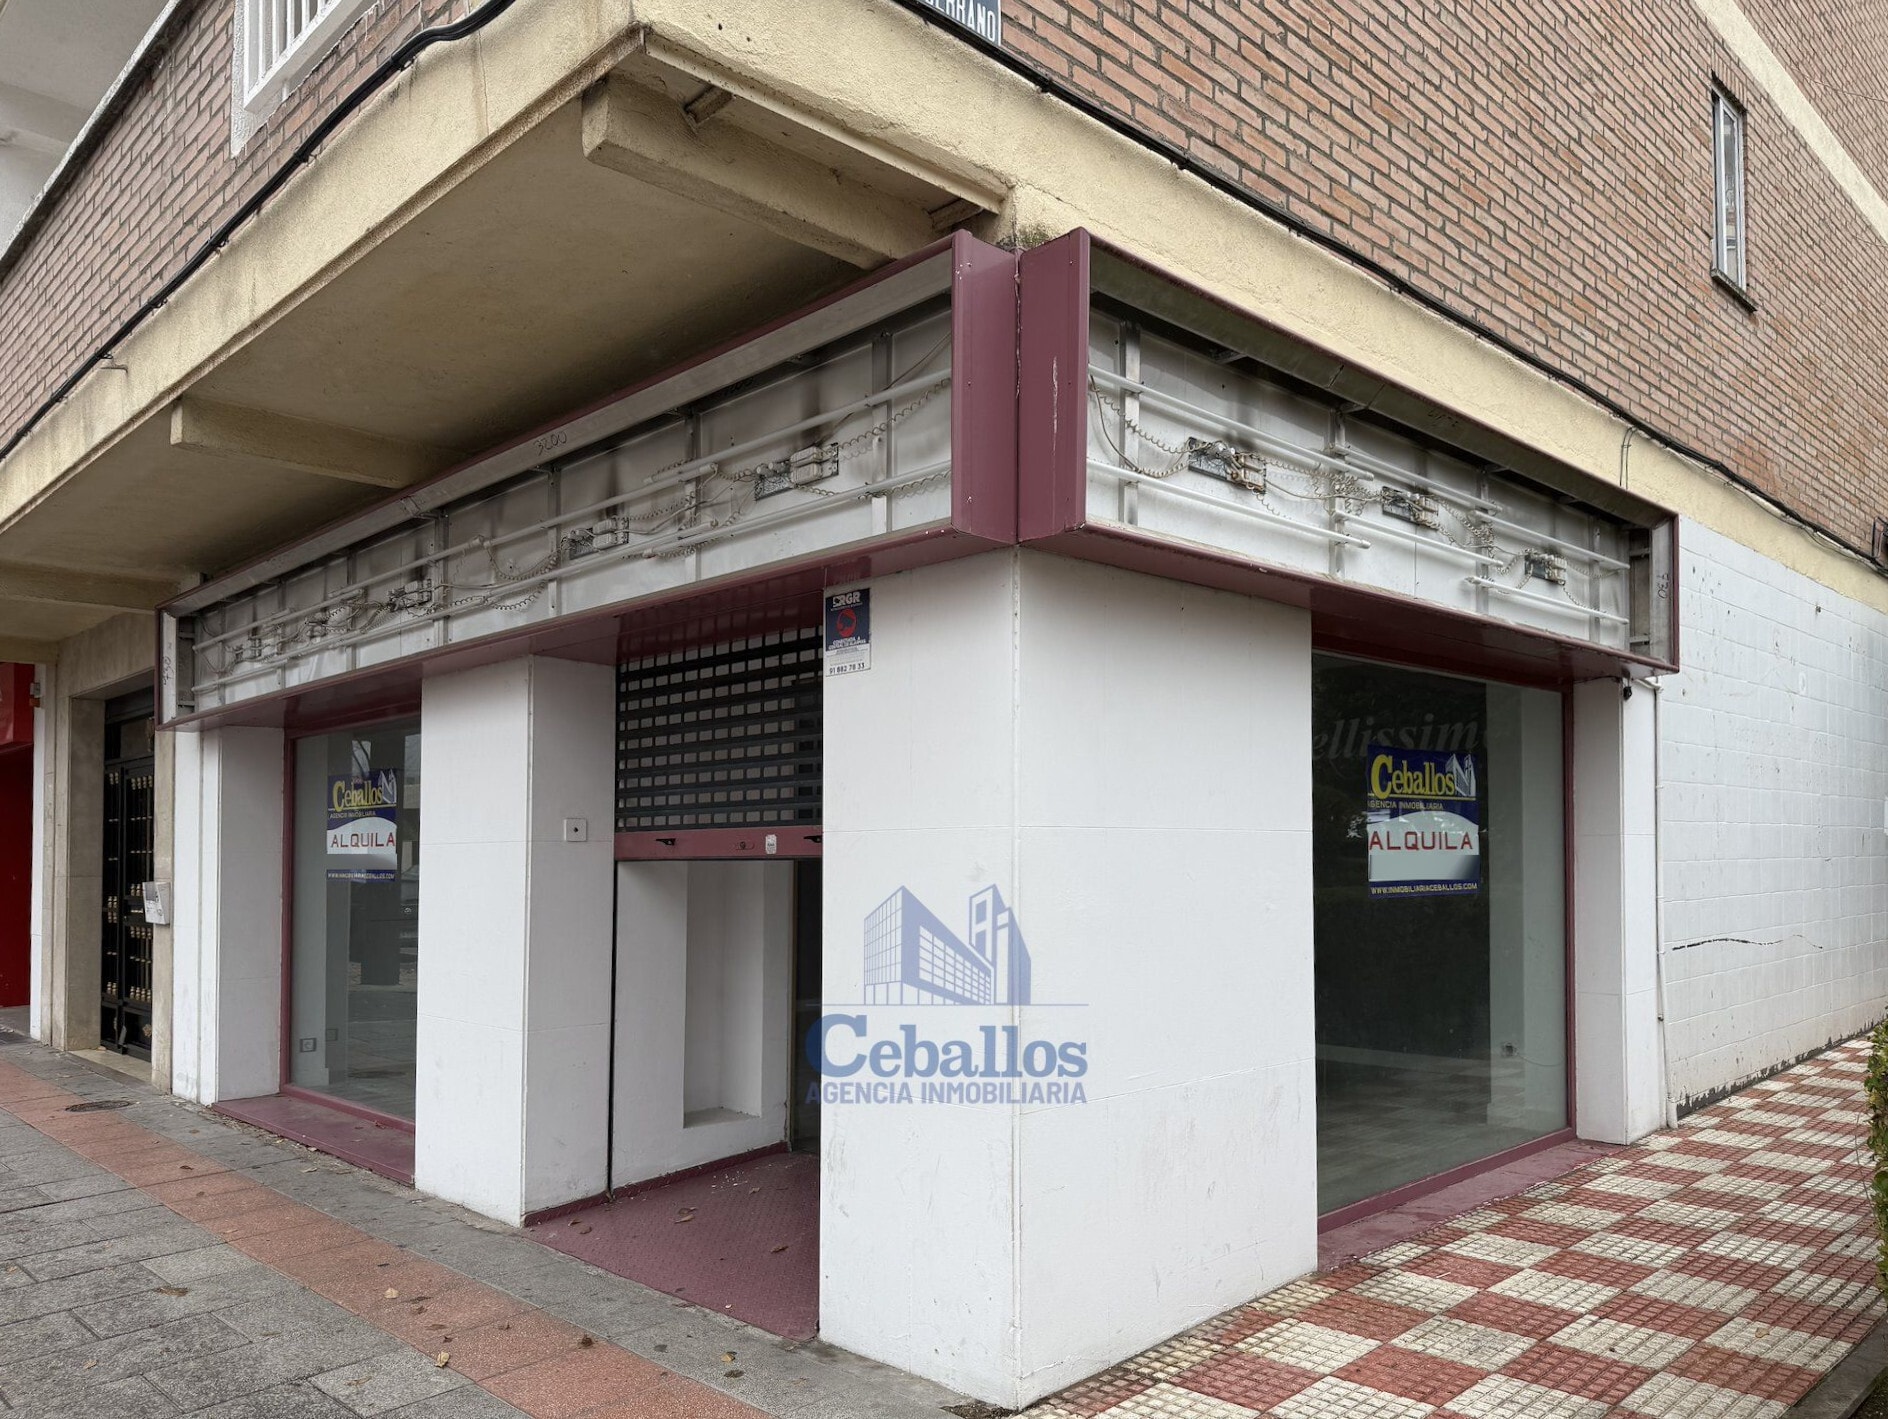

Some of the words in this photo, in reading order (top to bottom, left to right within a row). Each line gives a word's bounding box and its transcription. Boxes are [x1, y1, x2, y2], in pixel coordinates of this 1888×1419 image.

[1371, 754, 1455, 799] Ceballos
[333, 780, 383, 812] Ceballos
[1399, 801, 1443, 810] INMOBILIARIA
[331, 832, 395, 848] ALQUILA
[1369, 831, 1473, 850] ALQUILA
[1371, 883, 1477, 895] WWW.INMOBILIARIACEBALLOS.COM
